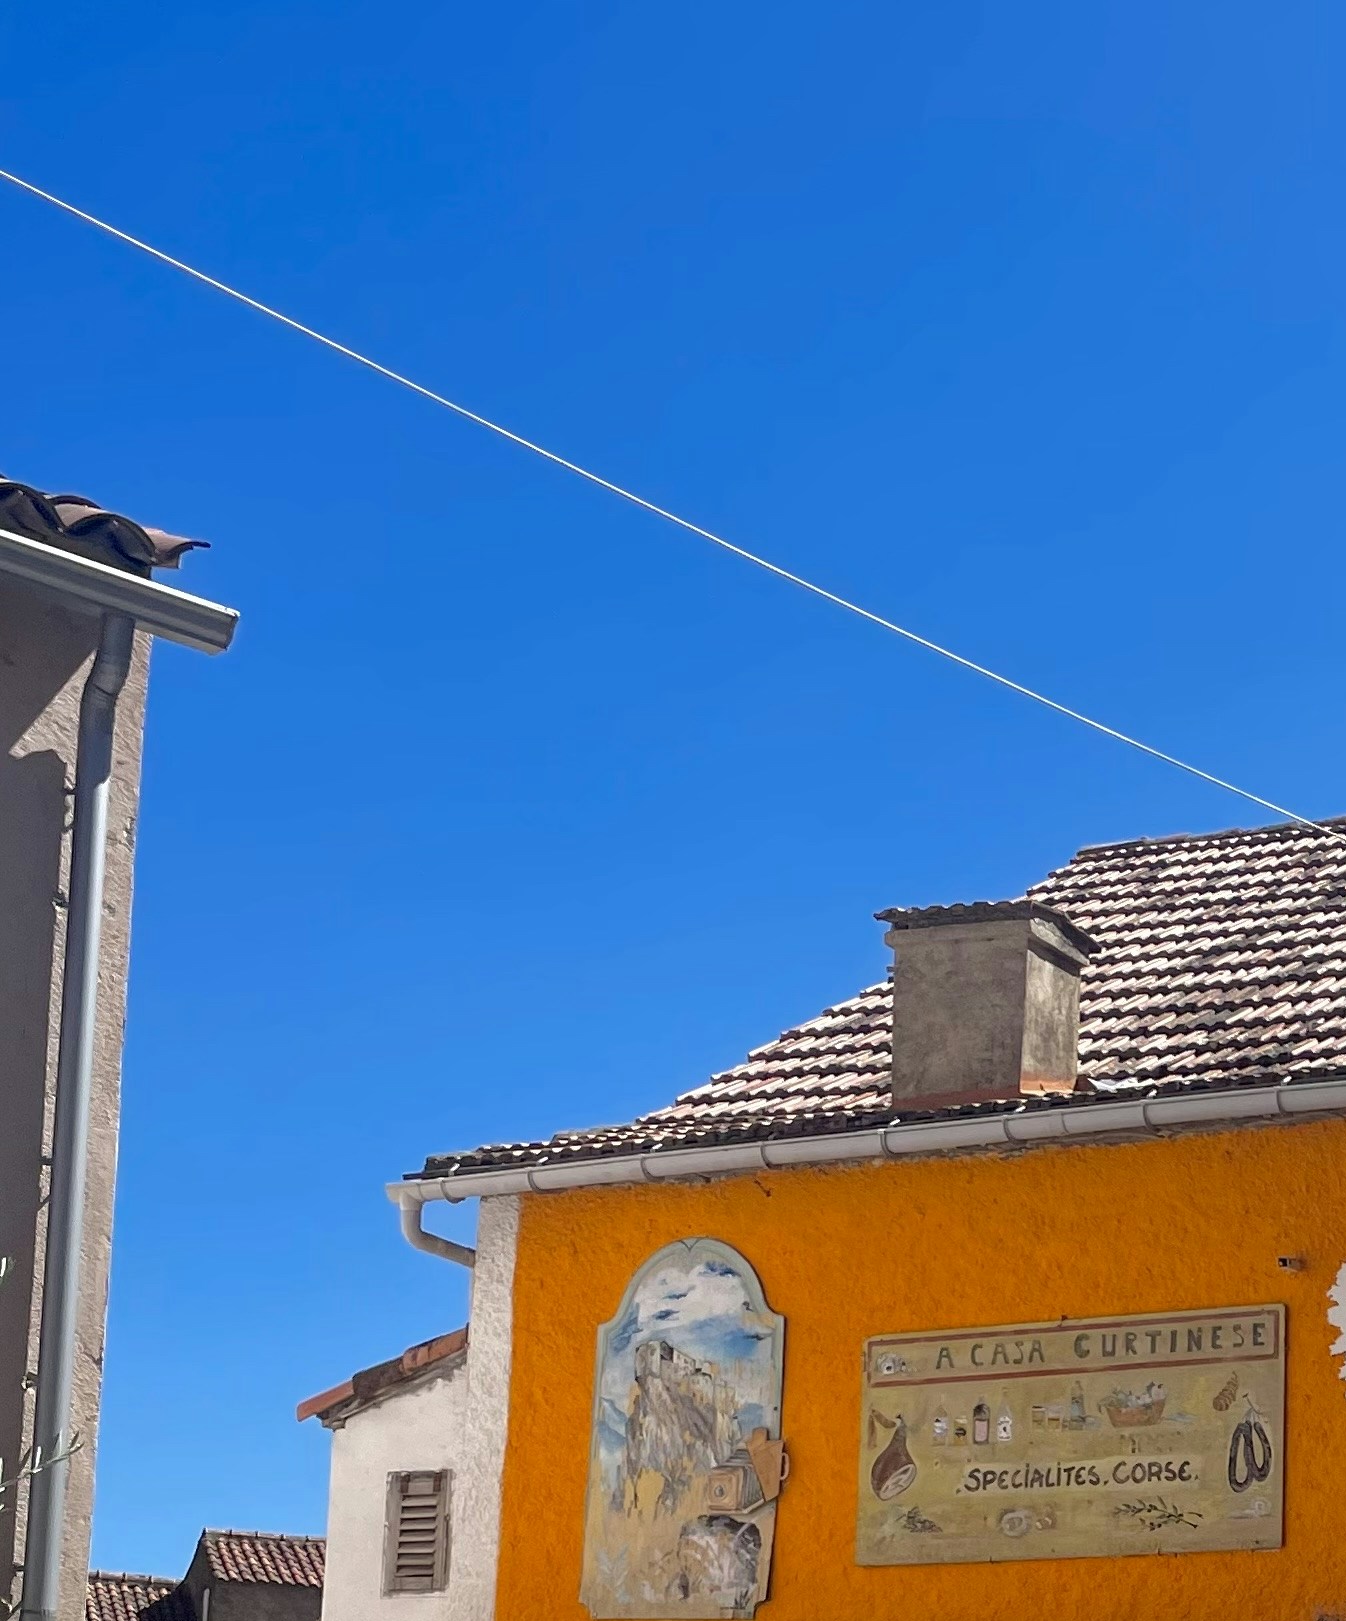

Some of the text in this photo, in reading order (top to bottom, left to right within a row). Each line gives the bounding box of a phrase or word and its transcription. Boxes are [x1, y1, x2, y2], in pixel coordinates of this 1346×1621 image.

[936, 1322, 1267, 1370] A CASA CURTINESE
